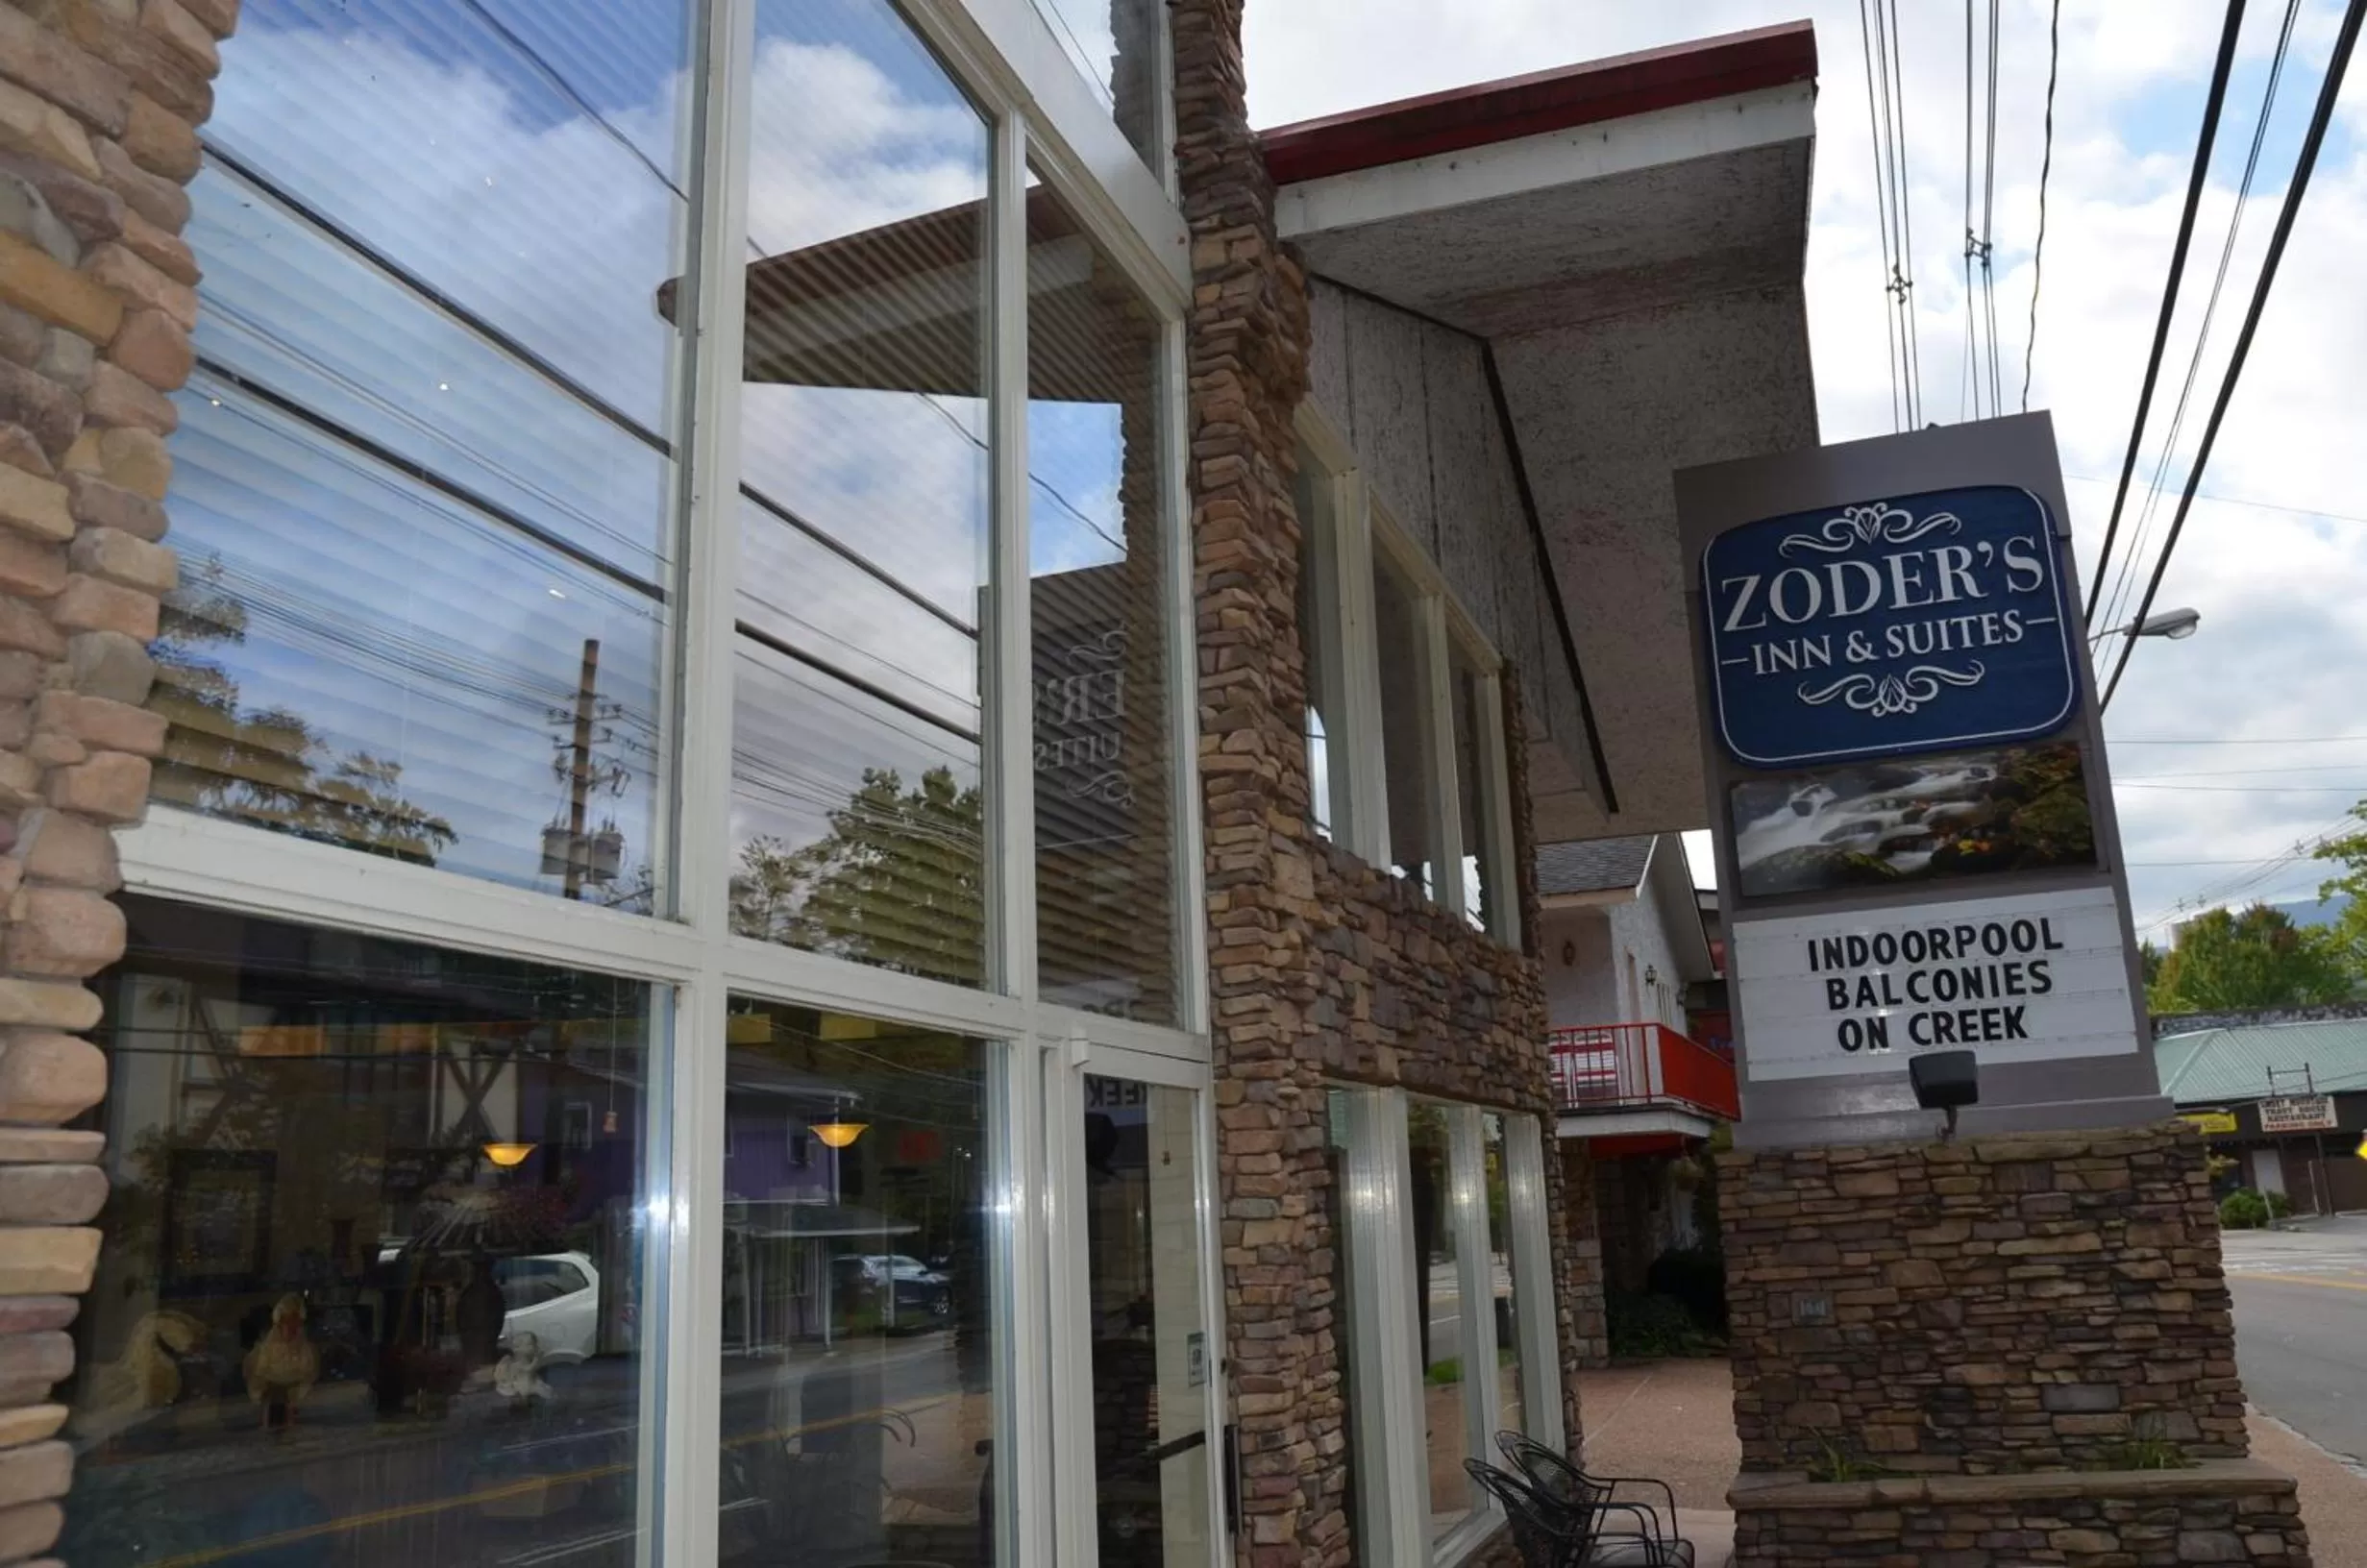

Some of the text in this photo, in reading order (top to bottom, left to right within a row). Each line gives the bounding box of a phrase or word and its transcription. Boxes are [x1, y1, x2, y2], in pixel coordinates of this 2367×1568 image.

[1721, 535, 2044, 632] ZODER'S
[1752, 608, 2024, 675] INN & SUITES
[1827, 959, 2053, 1011] BALCONIES
[1837, 1005, 2029, 1053] ON CREEK
